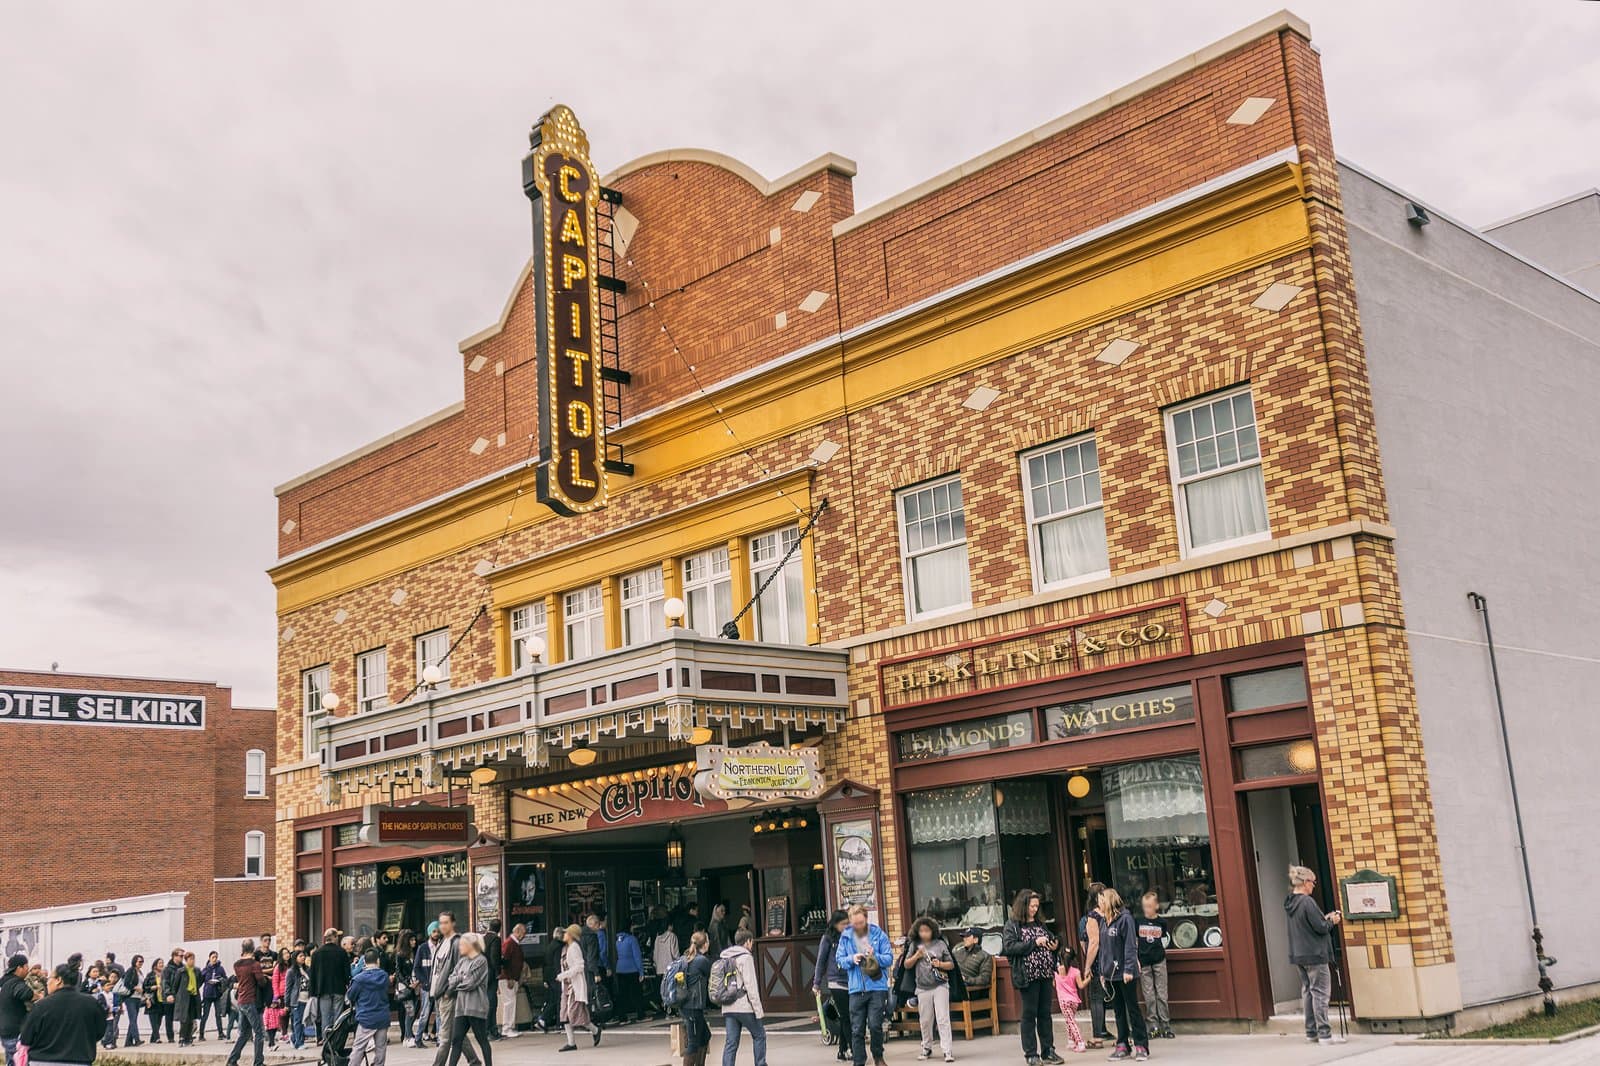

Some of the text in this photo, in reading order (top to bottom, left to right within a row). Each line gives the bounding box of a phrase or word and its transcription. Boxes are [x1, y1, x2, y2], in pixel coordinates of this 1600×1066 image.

[559, 164, 596, 488] CAPITOL
[1083, 636, 1106, 655] &
[1116, 623, 1171, 648] CO.
[76, 696, 197, 723] SELKIRK
[1061, 696, 1177, 730] WATCHES
[911, 721, 1025, 754] DIAMONDS
[723, 762, 805, 775] NORTHERN LIGHT
[381, 822, 464, 831] THE HOME OF SUPER PICTURES
[528, 813, 554, 827] THE
[558, 808, 588, 823] NEW
[428, 861, 448, 880] PIPE
[1127, 851, 1188, 870] KLINE'S
[339, 870, 377, 891] PIPE SHOP
[938, 868, 991, 886] KLINE'S
